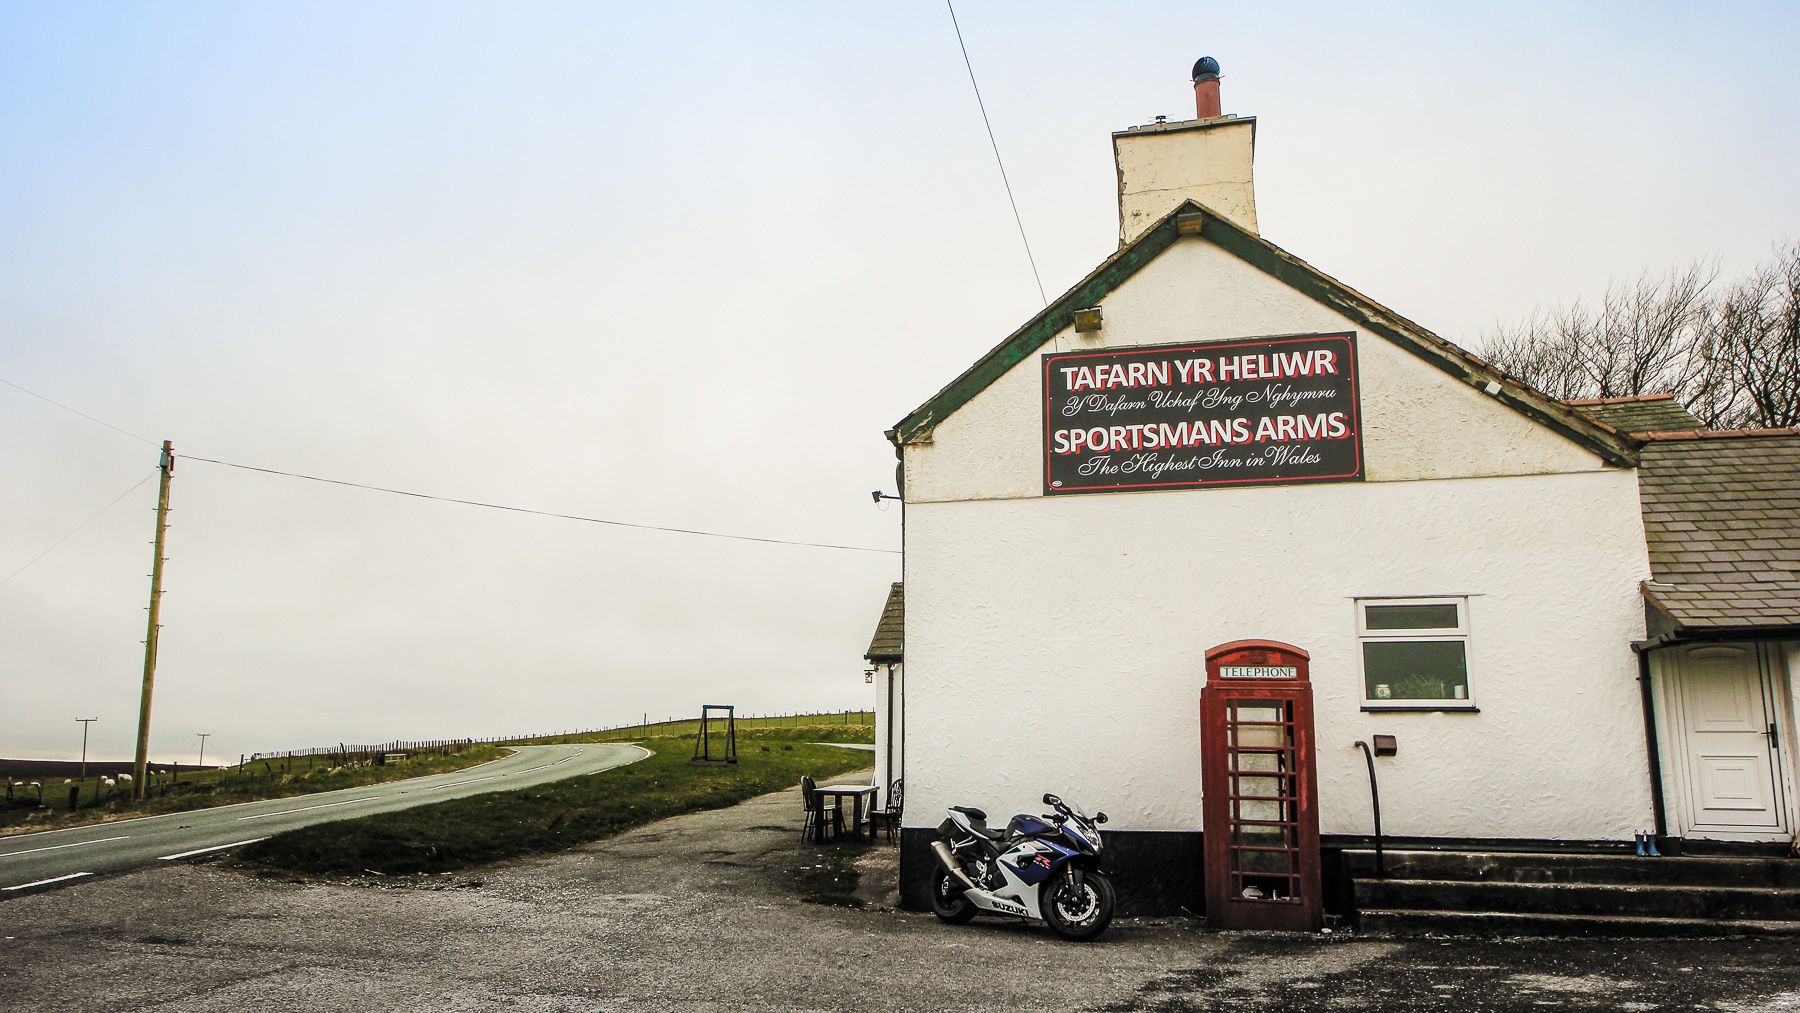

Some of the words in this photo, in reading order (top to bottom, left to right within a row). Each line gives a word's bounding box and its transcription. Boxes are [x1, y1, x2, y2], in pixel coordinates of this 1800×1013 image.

[1060, 361, 1170, 391] TAFARN
[1174, 358, 1214, 385] YR
[1219, 350, 1337, 381] HELIWR
[1062, 395, 1088, 417] Y
[1086, 394, 1146, 416] Dafarn
[1148, 390, 1204, 413] Uchaf
[1202, 387, 1243, 410] Yng
[1246, 384, 1336, 408] Nghymru
[1054, 417, 1252, 455] SPORTSMANS
[1255, 412, 1348, 442] ARMS
[1078, 455, 1119, 476] The
[1121, 453, 1199, 479] Highest
[1198, 449, 1242, 469] Inn
[1246, 452, 1265, 467] in
[1264, 445, 1321, 466] Wales
[1223, 667, 1295, 677] TELEPHONE
[991, 900, 1029, 917] SUZUKI
